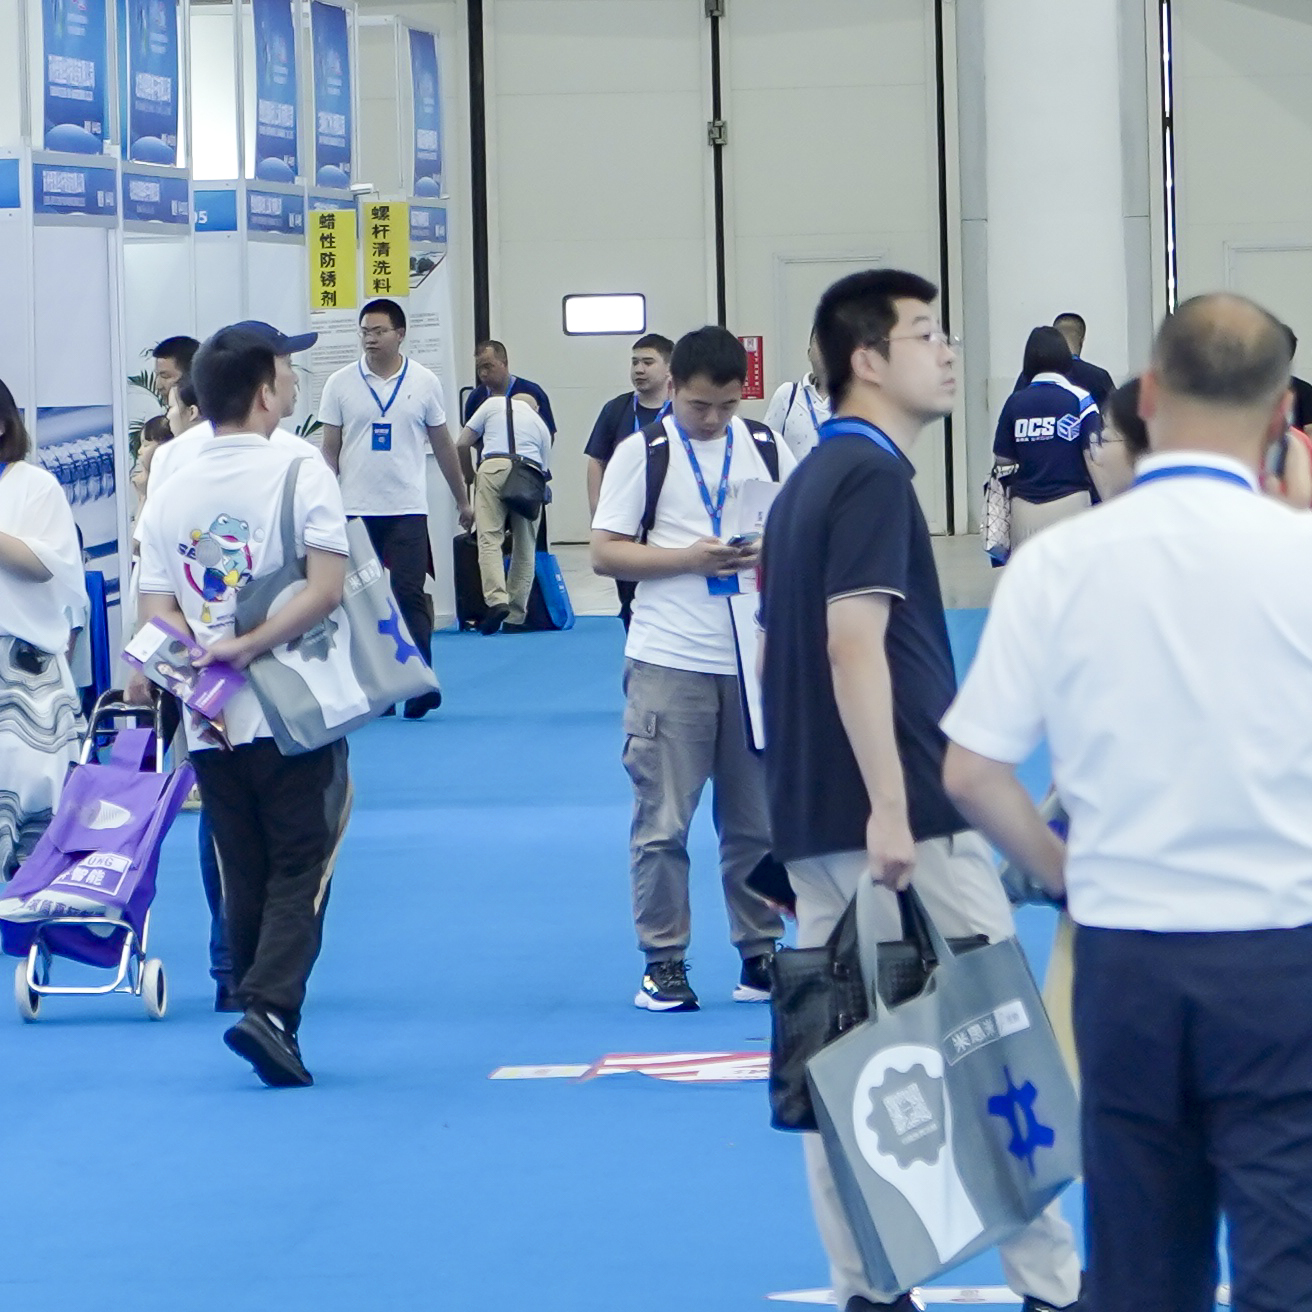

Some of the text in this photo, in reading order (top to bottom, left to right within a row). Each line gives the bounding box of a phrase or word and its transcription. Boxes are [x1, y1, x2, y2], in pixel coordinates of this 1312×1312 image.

[319, 212, 337, 308] 蜡性防锈剂
[371, 205, 392, 294] 螺杆清洗料
